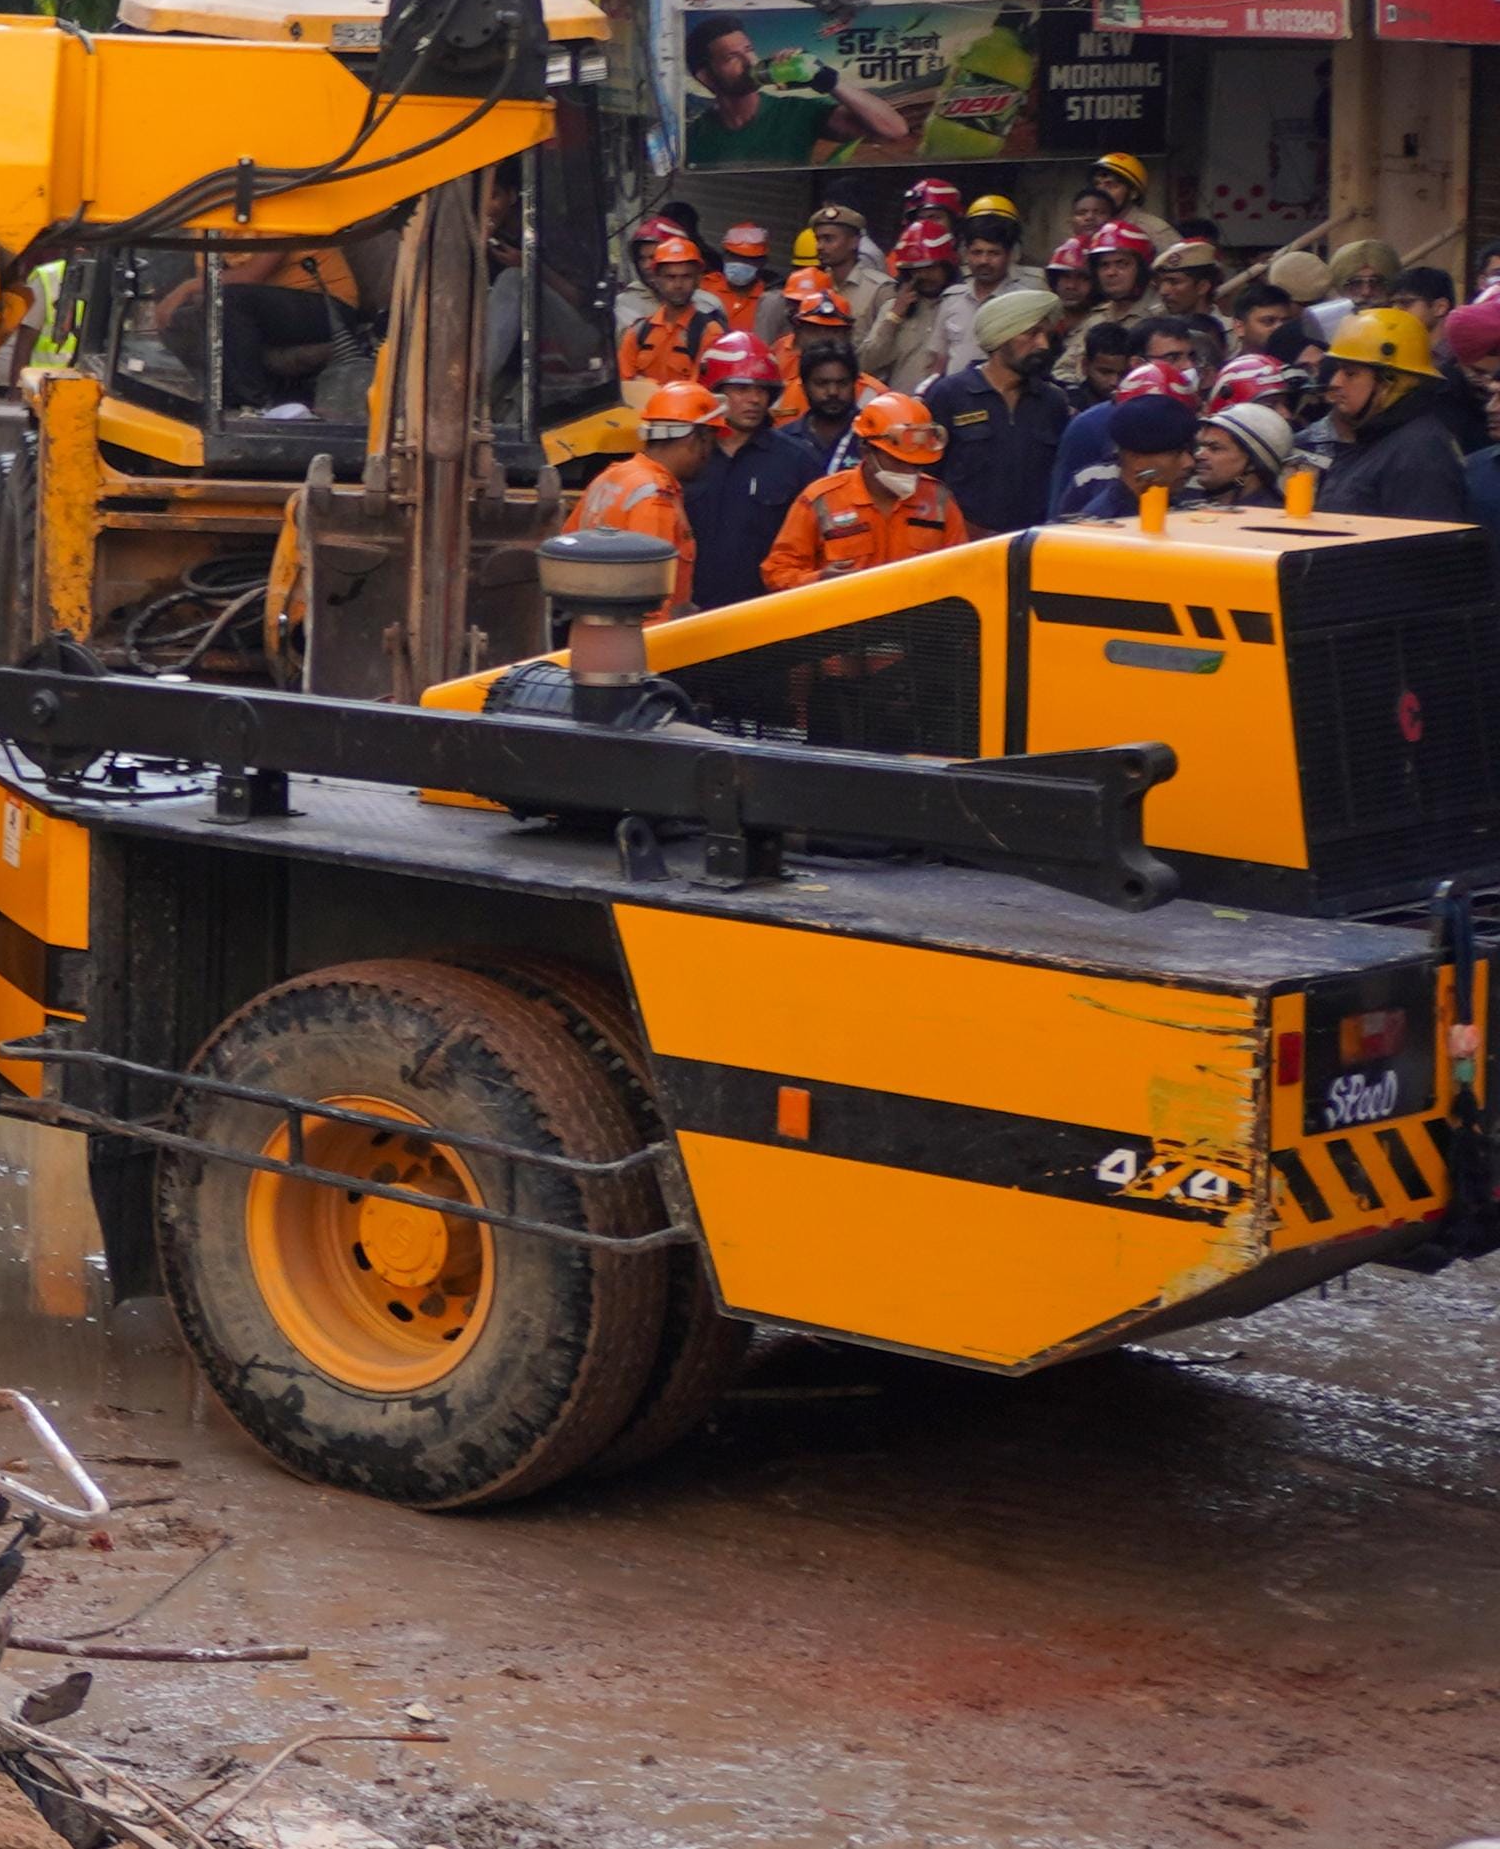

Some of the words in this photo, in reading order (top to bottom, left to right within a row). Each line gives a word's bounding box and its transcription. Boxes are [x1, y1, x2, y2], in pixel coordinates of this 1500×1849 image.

[1078, 33, 1134, 58] NEW
[1049, 62, 1162, 90] MORNING
[1066, 94, 1143, 121] STORE
